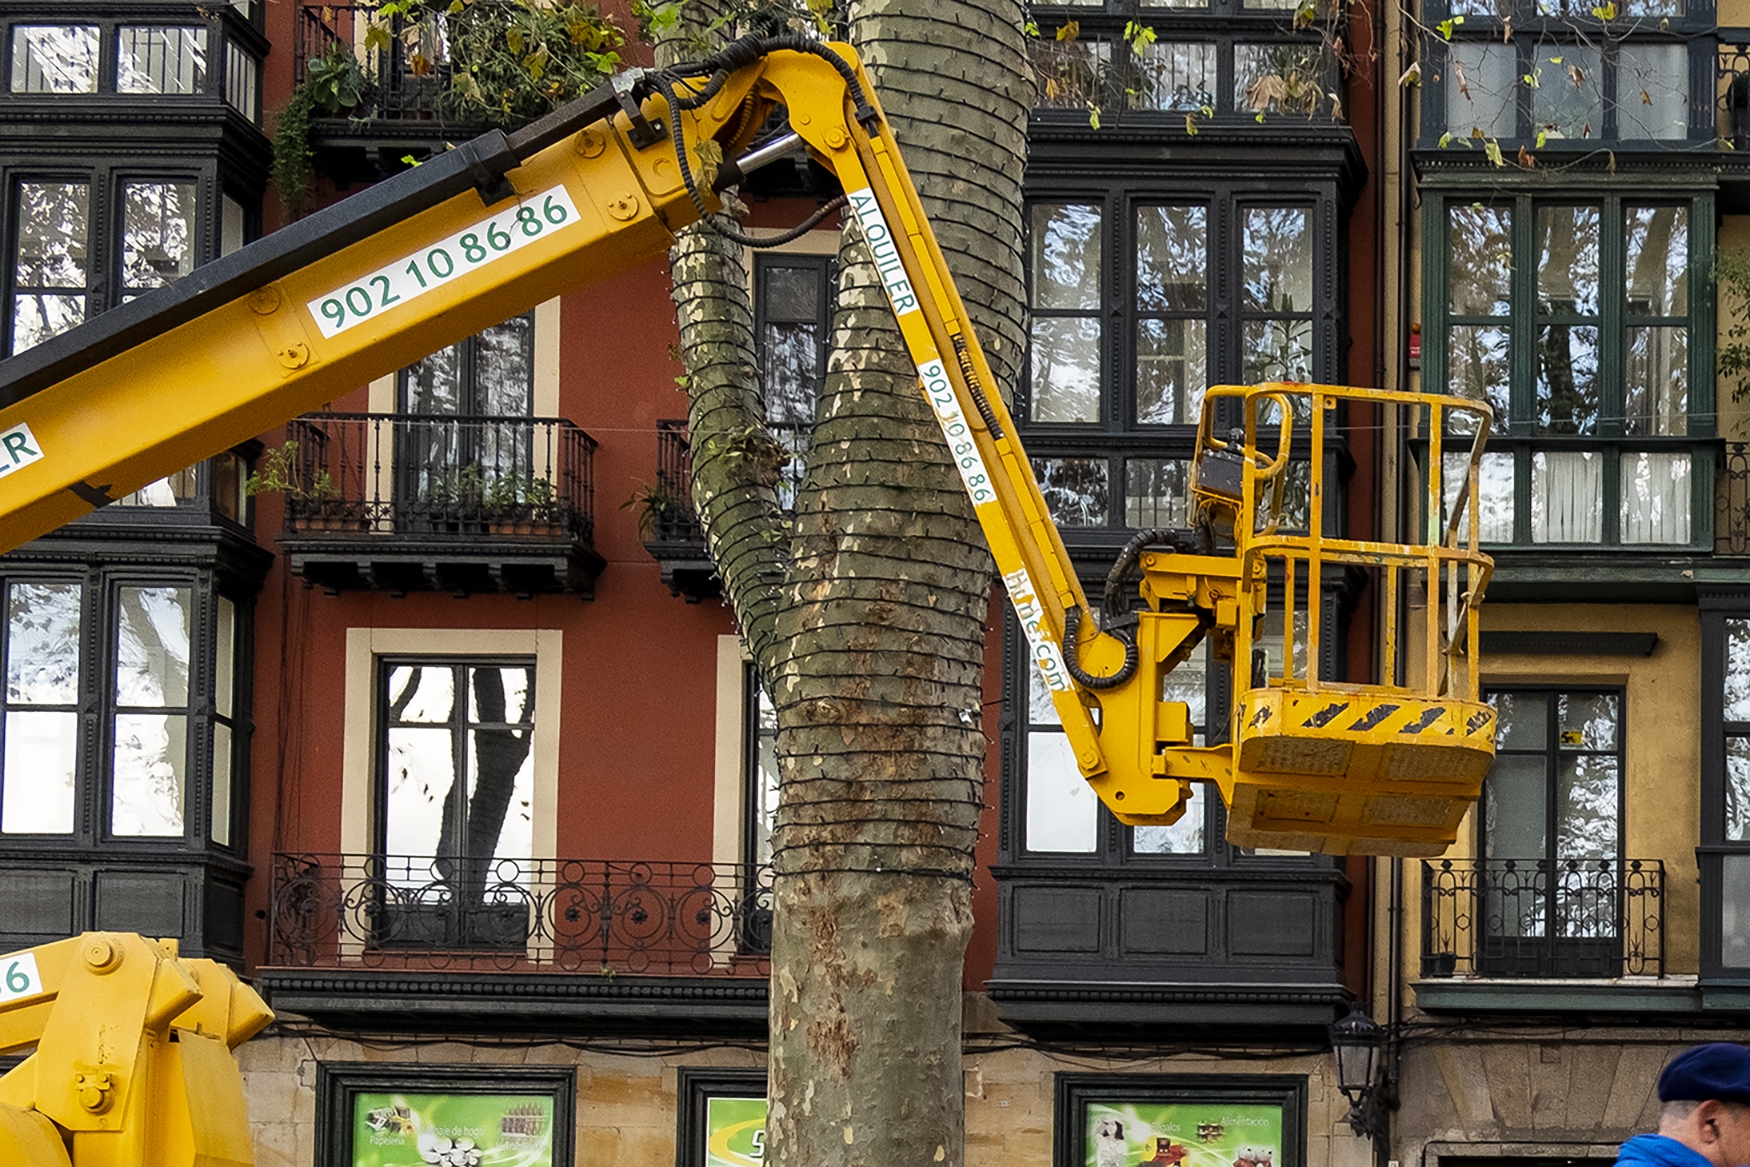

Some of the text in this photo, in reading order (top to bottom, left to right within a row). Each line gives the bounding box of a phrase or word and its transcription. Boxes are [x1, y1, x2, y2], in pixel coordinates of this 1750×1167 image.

[320, 195, 568, 329] 902 10 86 86
[850, 194, 915, 314] ALQUILER
[923, 365, 953, 408] 902
[954, 441, 978, 470] 86
[968, 473, 991, 502] 86
[0, 960, 31, 994] 6
